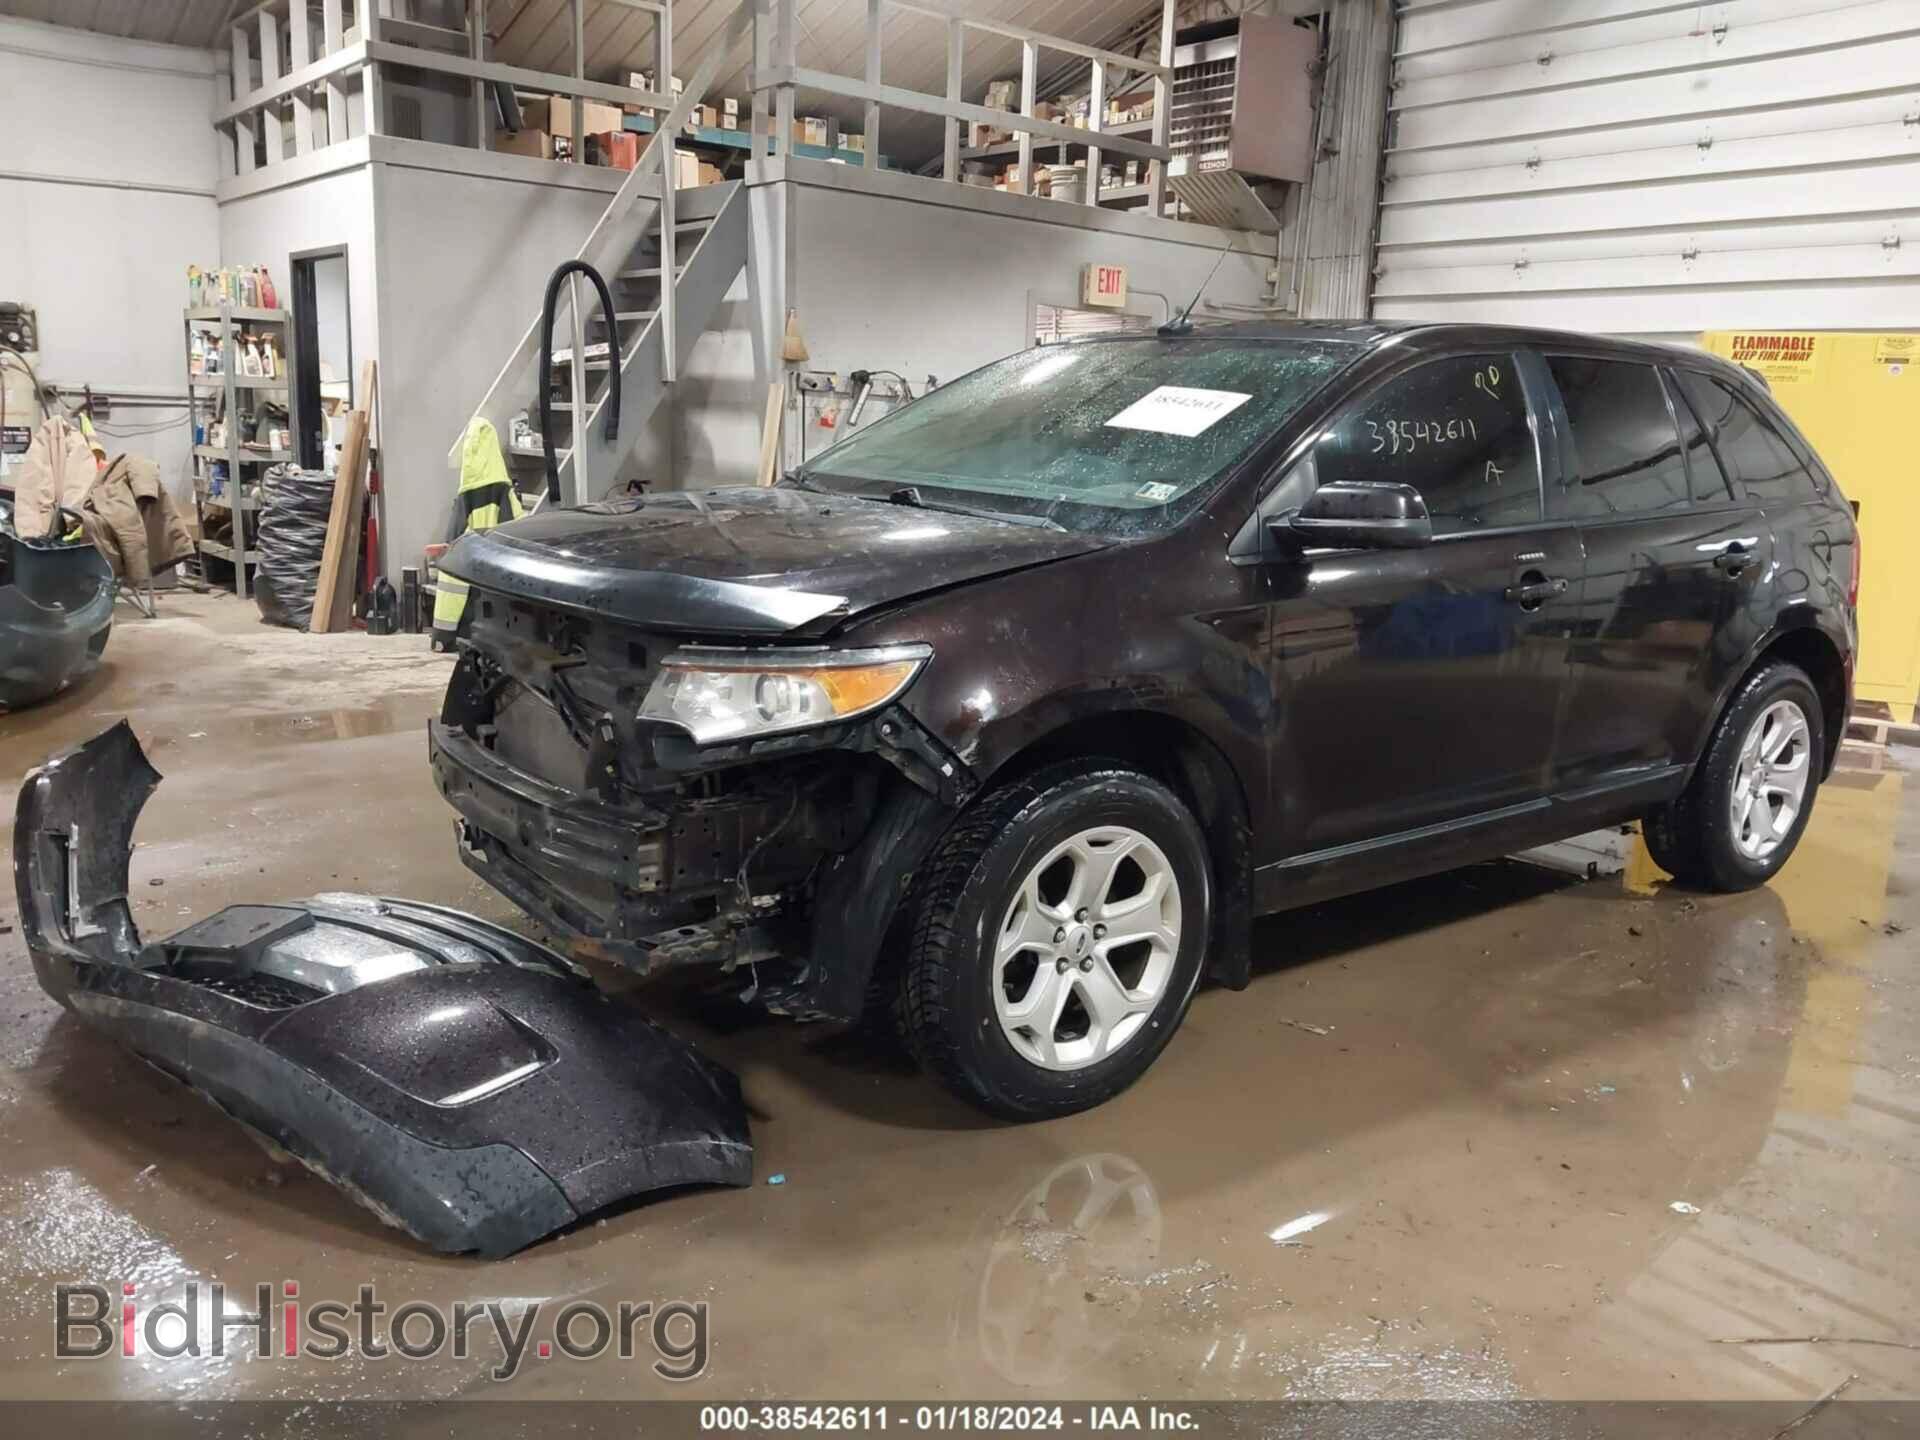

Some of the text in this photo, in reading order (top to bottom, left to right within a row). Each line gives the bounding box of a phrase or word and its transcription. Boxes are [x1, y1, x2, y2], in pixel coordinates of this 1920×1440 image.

[1098, 267, 1122, 293] EXIT
[1731, 350, 1814, 362] KEEP FIRE AWAY
[1732, 336, 1816, 351] FLAMMABLE
[1365, 417, 1478, 455] 38542611
[1484, 460, 1504, 486] A
